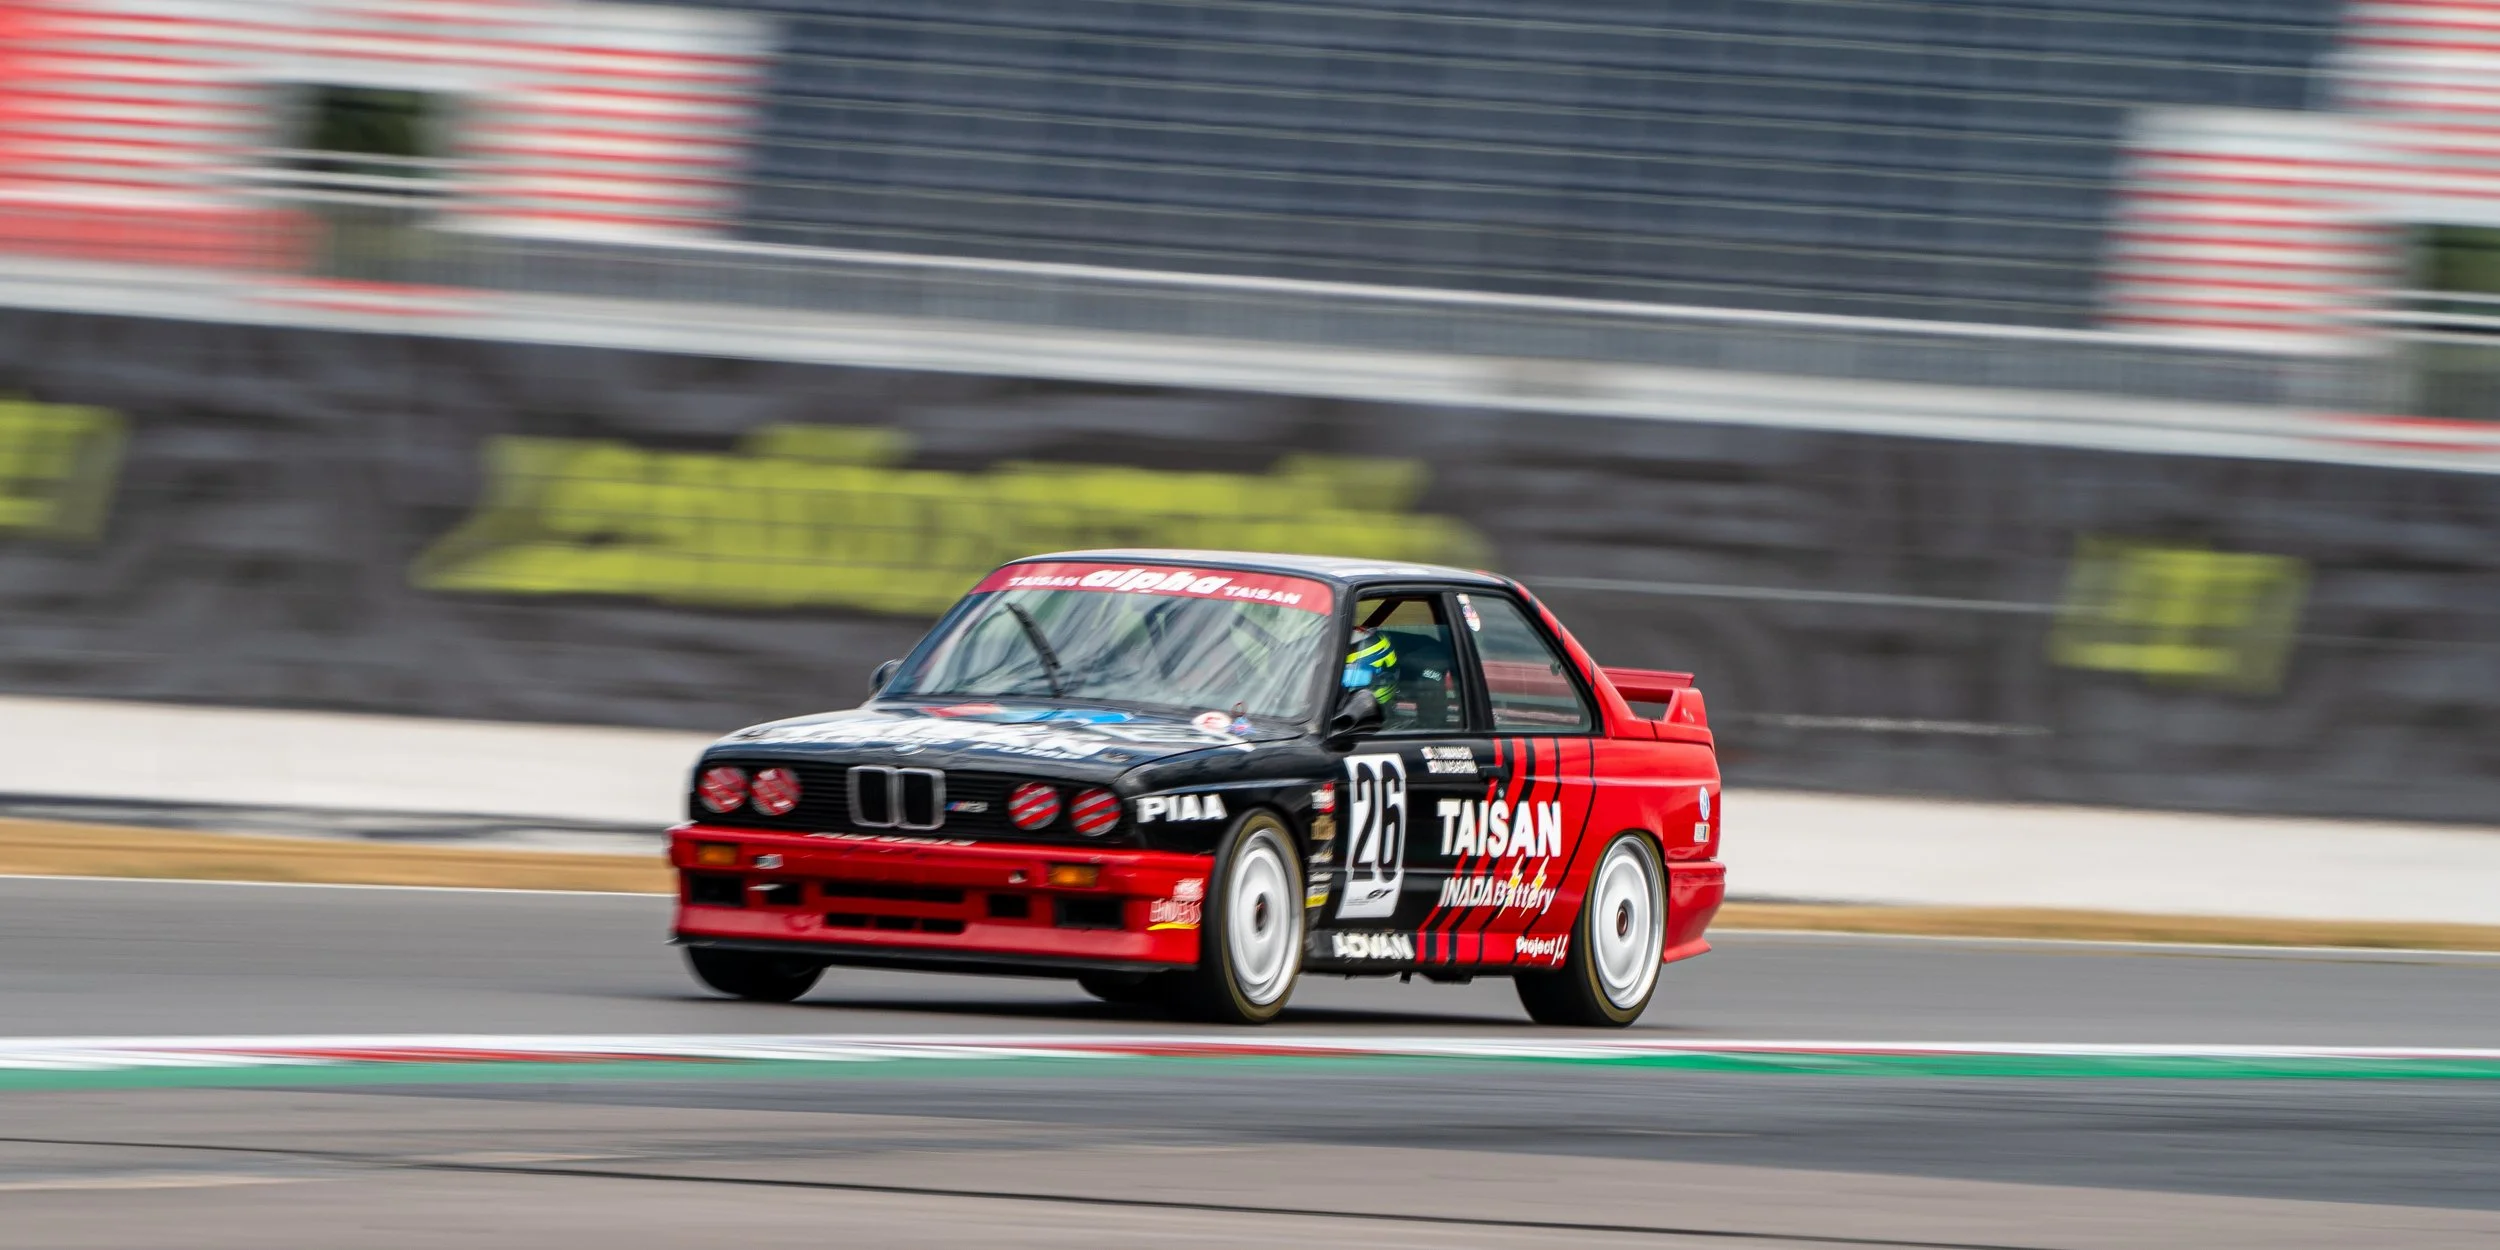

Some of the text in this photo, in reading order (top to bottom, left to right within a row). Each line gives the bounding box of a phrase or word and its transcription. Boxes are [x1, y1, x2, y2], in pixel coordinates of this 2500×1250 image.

[1008, 568, 1302, 604] TAISAN alpha TAISAN
[1137, 794, 1228, 823] PIAA
[1352, 760, 1401, 883] 26
[1437, 799, 1561, 857] TAISAN
[1332, 932, 1415, 959] ADVAN
[1516, 936, 1555, 957] Project
